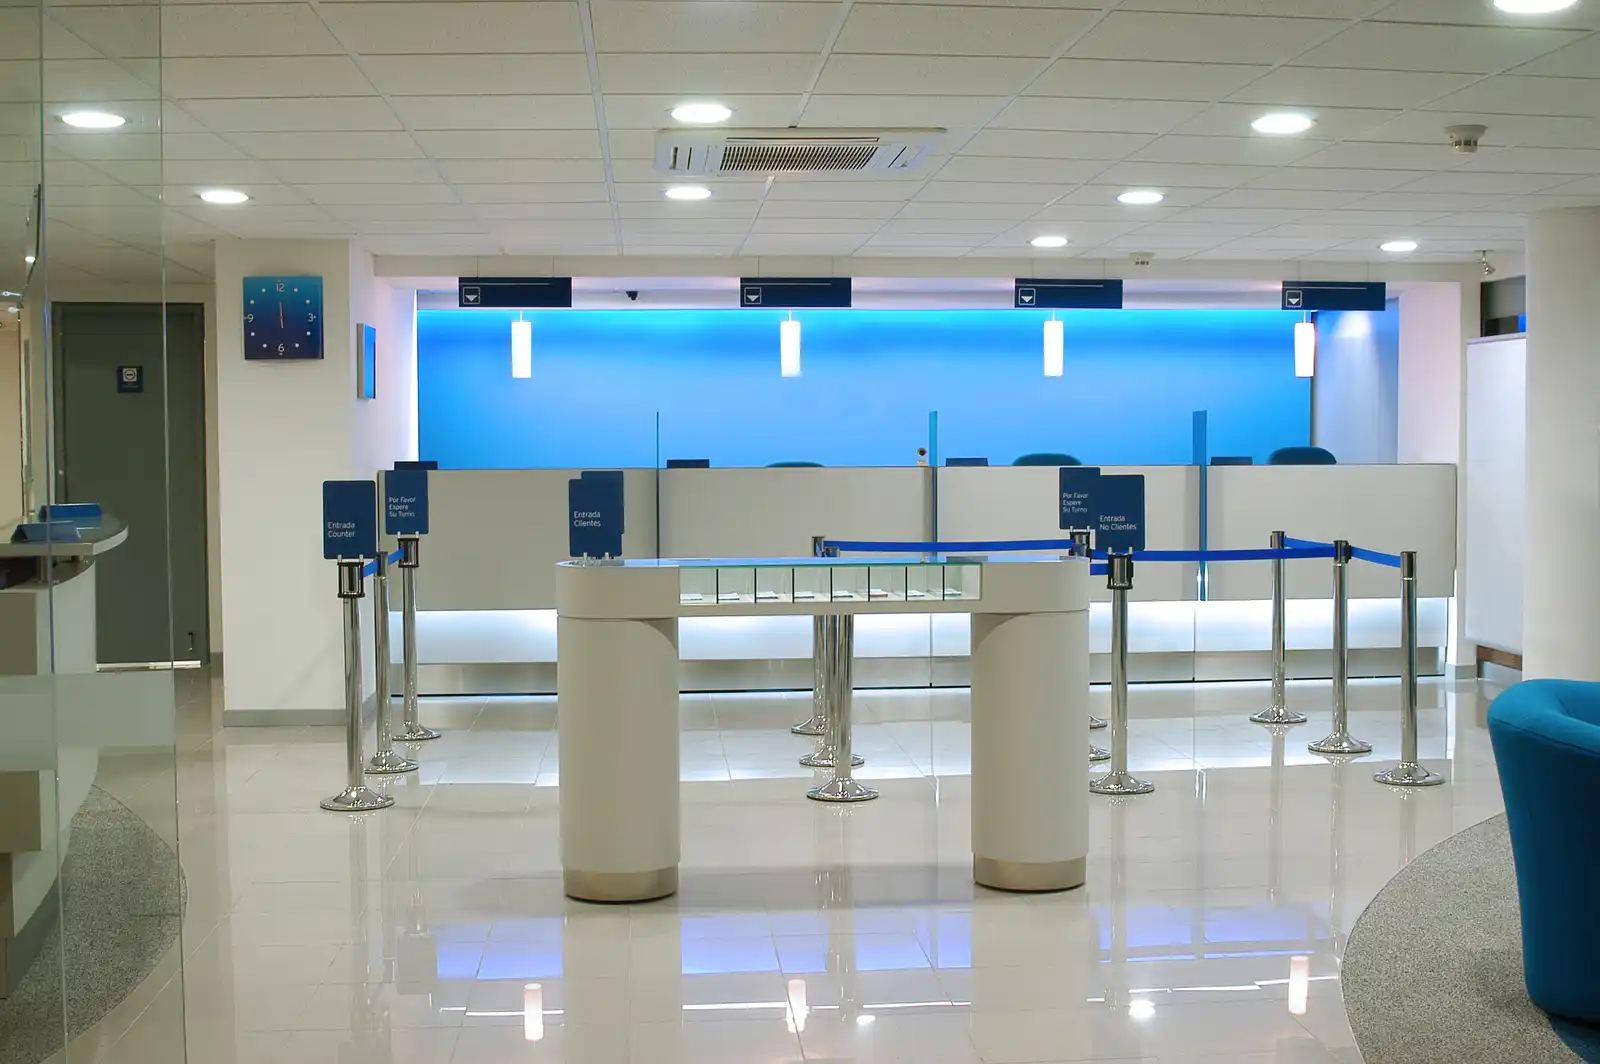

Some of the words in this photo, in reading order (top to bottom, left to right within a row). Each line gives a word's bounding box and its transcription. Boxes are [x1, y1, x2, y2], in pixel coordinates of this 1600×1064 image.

[275, 283, 285, 292] 12
[247, 313, 254, 322] 9
[307, 312, 314, 322] 3
[278, 343, 285, 352] 6
[398, 510, 415, 518] Turno
[573, 510, 601, 518] Entrada
[1099, 514, 1126, 522] Entrada
[327, 521, 356, 529] Entrada
[573, 519, 601, 527] Clientes
[1099, 523, 1109, 531] No
[327, 530, 356, 538] Counter
